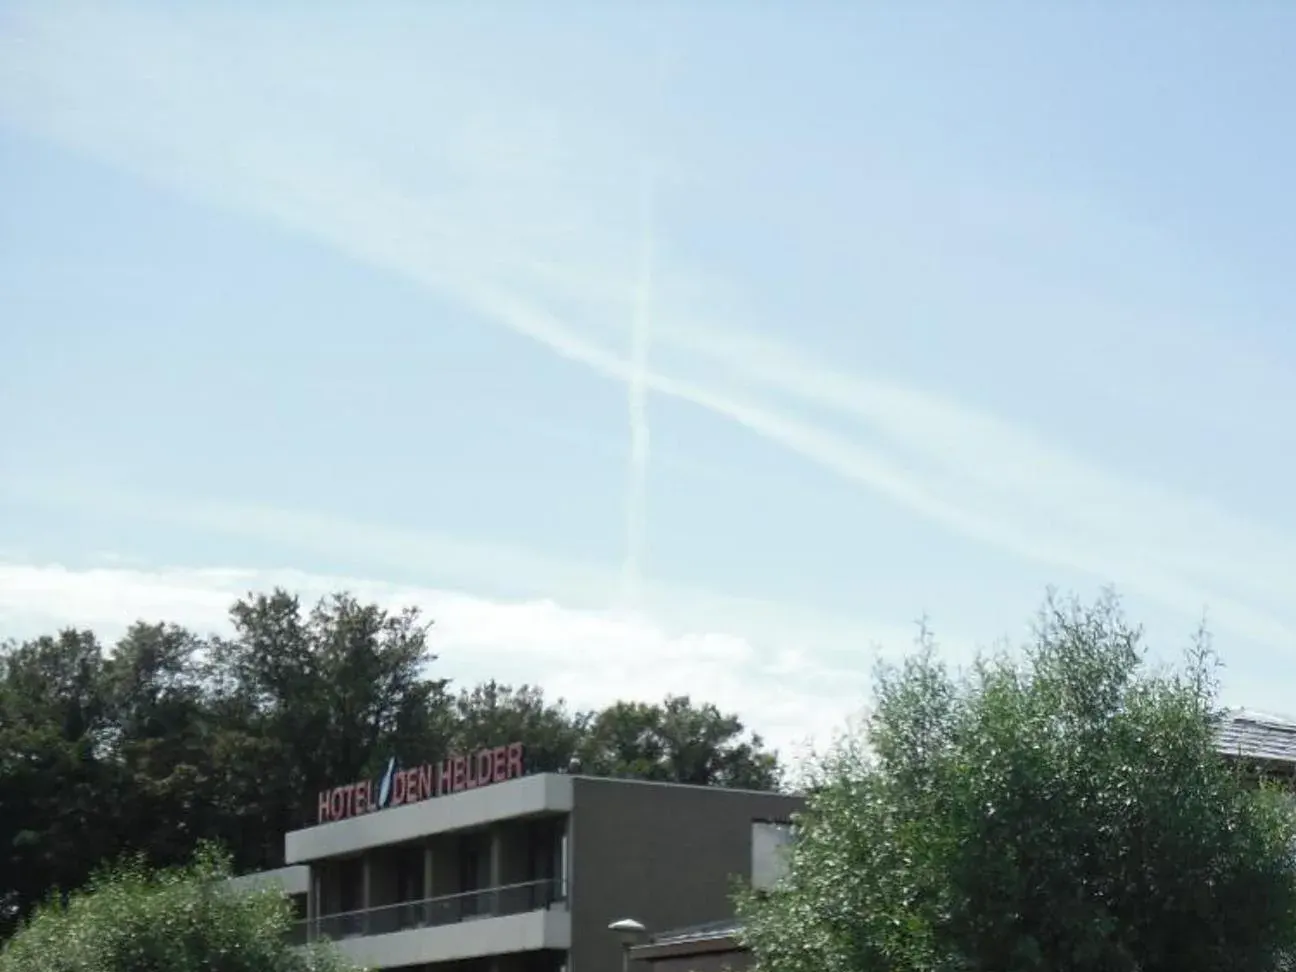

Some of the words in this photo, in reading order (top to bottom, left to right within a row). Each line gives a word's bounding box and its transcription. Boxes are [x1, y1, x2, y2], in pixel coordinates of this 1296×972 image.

[317, 778, 377, 824] HOTEL
[390, 763, 432, 806] DEN
[436, 741, 525, 797] HELDER
